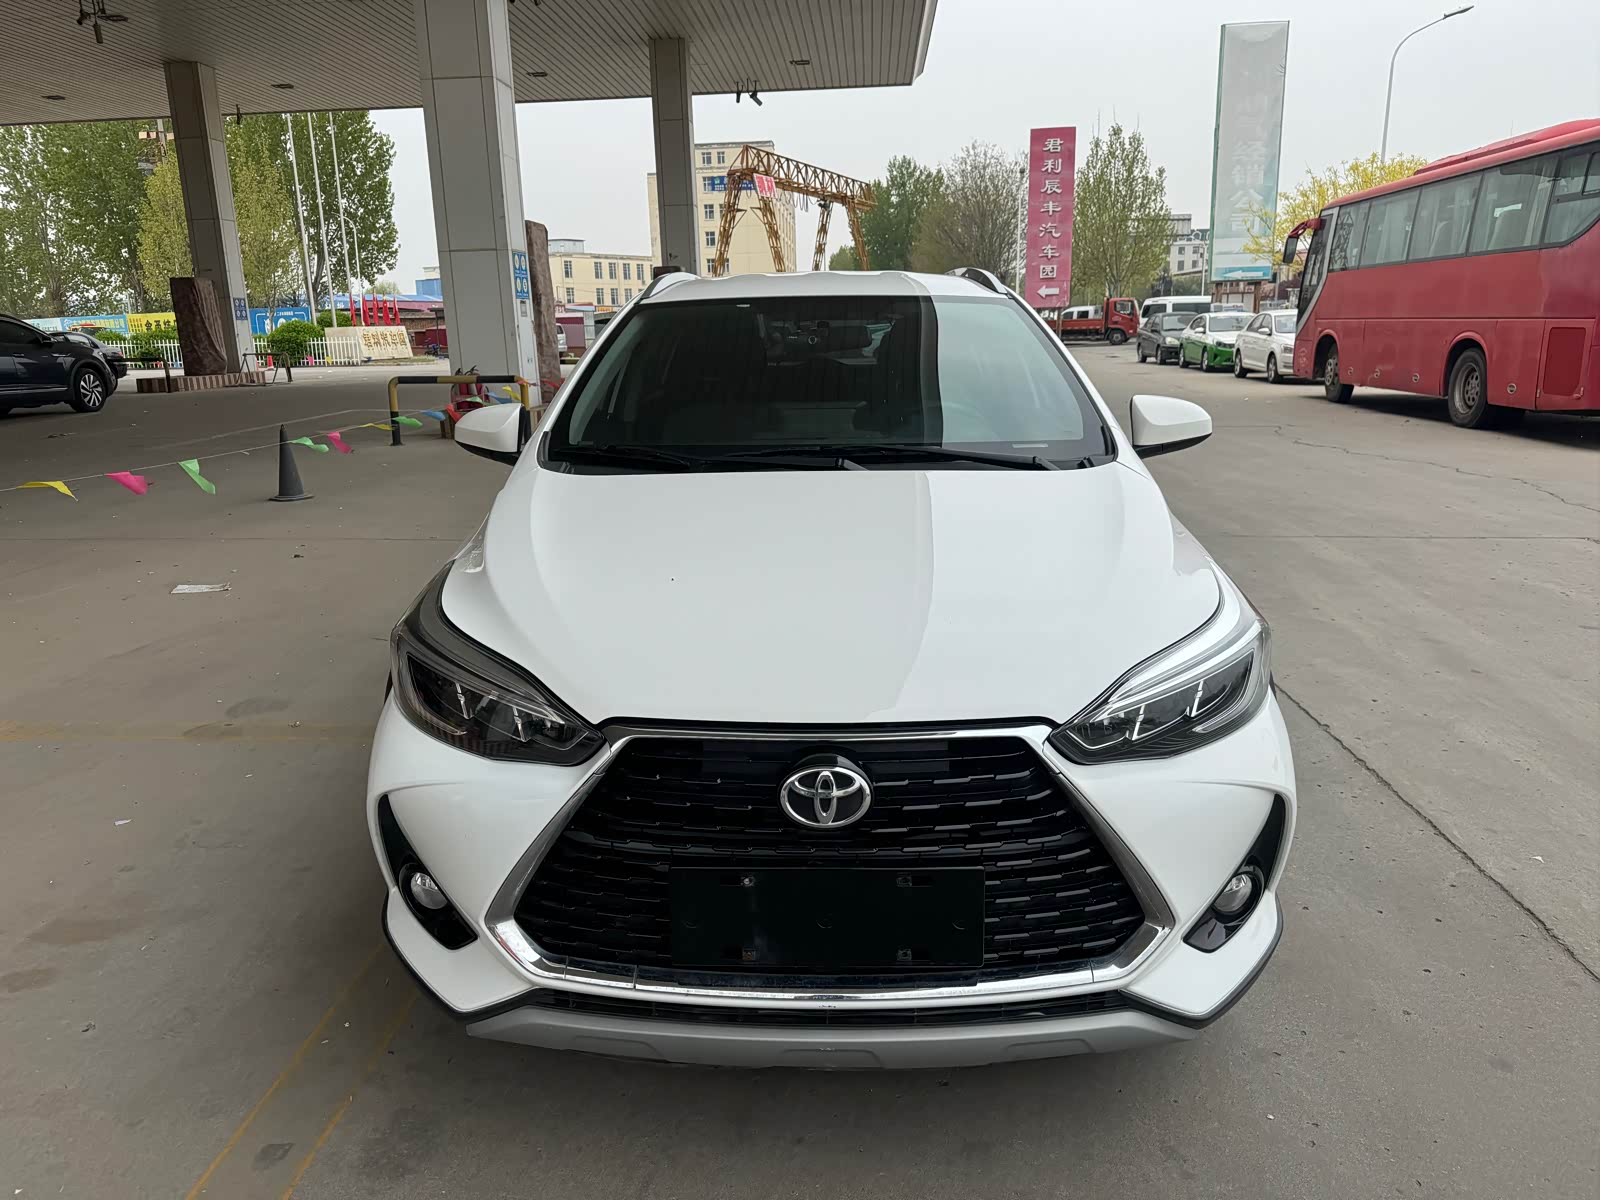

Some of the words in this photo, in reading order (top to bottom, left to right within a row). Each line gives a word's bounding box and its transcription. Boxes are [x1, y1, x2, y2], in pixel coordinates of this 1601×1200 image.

[1038, 138, 1063, 279] 君利辰丰汽车园
